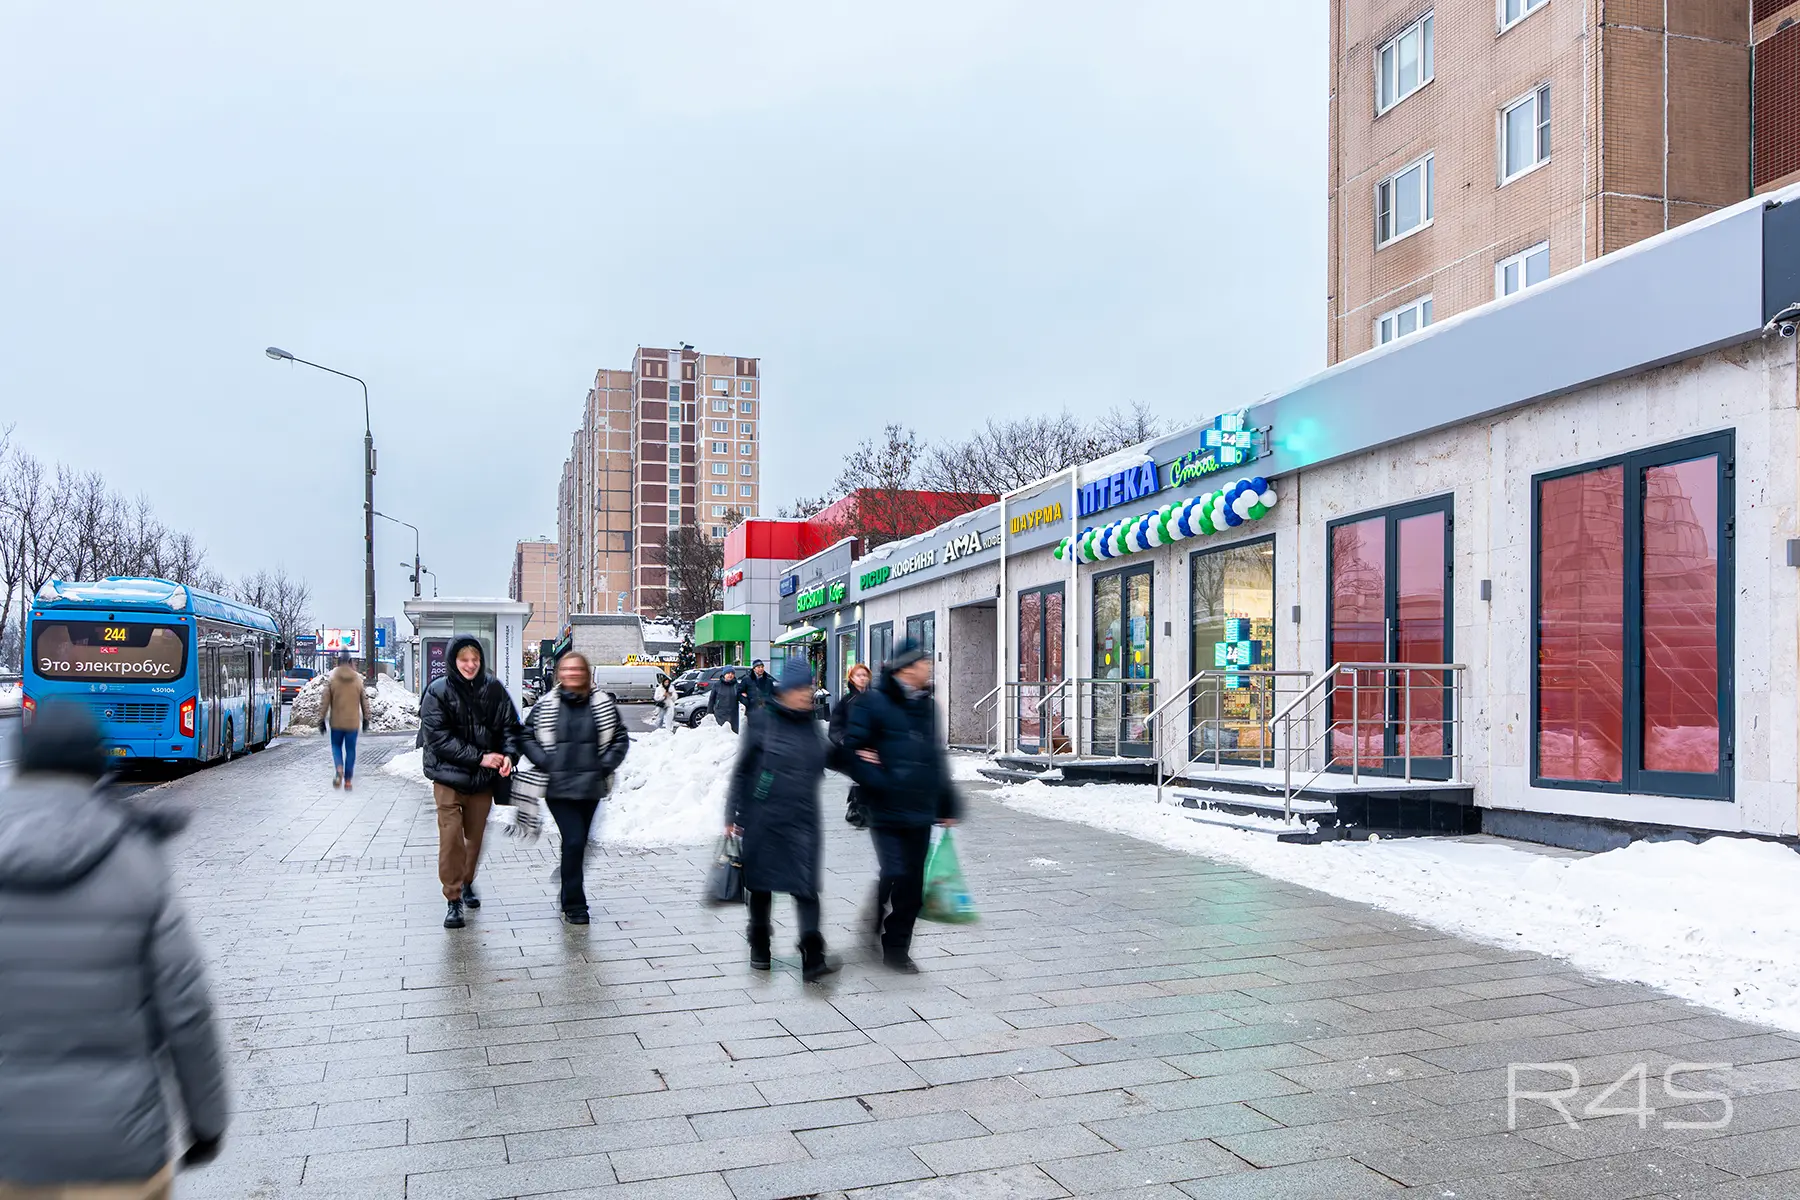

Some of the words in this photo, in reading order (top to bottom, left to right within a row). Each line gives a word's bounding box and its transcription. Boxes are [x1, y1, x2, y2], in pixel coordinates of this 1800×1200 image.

[1222, 433, 1237, 446] 24
[1069, 461, 1159, 520] АПТЕКА
[1010, 502, 1062, 535] ШАУРМА
[860, 565, 890, 591] PICUP
[891, 549, 935, 579] КОФЕЙНЯ
[104, 627, 126, 641] 244
[627, 653, 661, 663] ШАУРМА
[1226, 645, 1239, 663] 24
[40, 658, 71, 672] Это
[75, 660, 175, 676] электробус.
